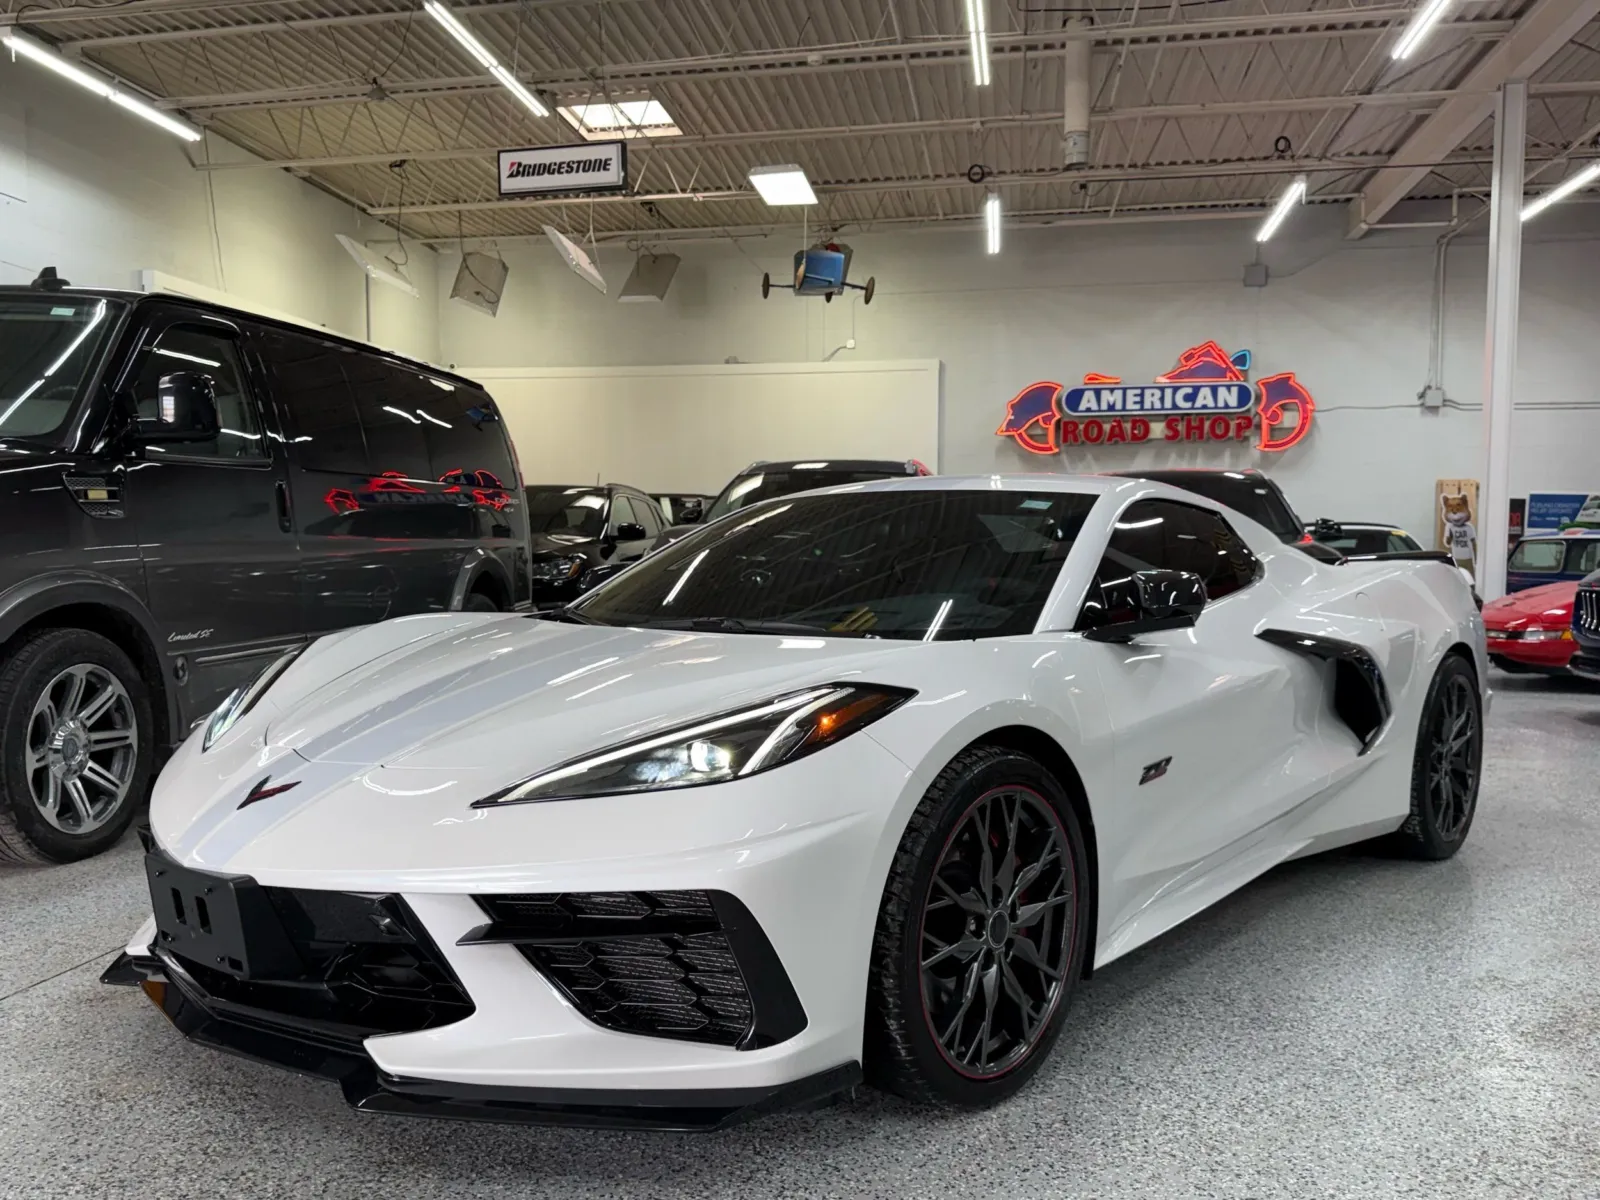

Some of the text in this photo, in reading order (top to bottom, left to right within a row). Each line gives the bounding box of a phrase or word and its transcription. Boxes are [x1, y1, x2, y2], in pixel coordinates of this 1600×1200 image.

[506, 157, 612, 179] BRIDGESTONE
[1078, 386, 1239, 412] AMERICAN
[1061, 416, 1254, 444] ROAD SHOP
[1455, 530, 1468, 538] CAR
